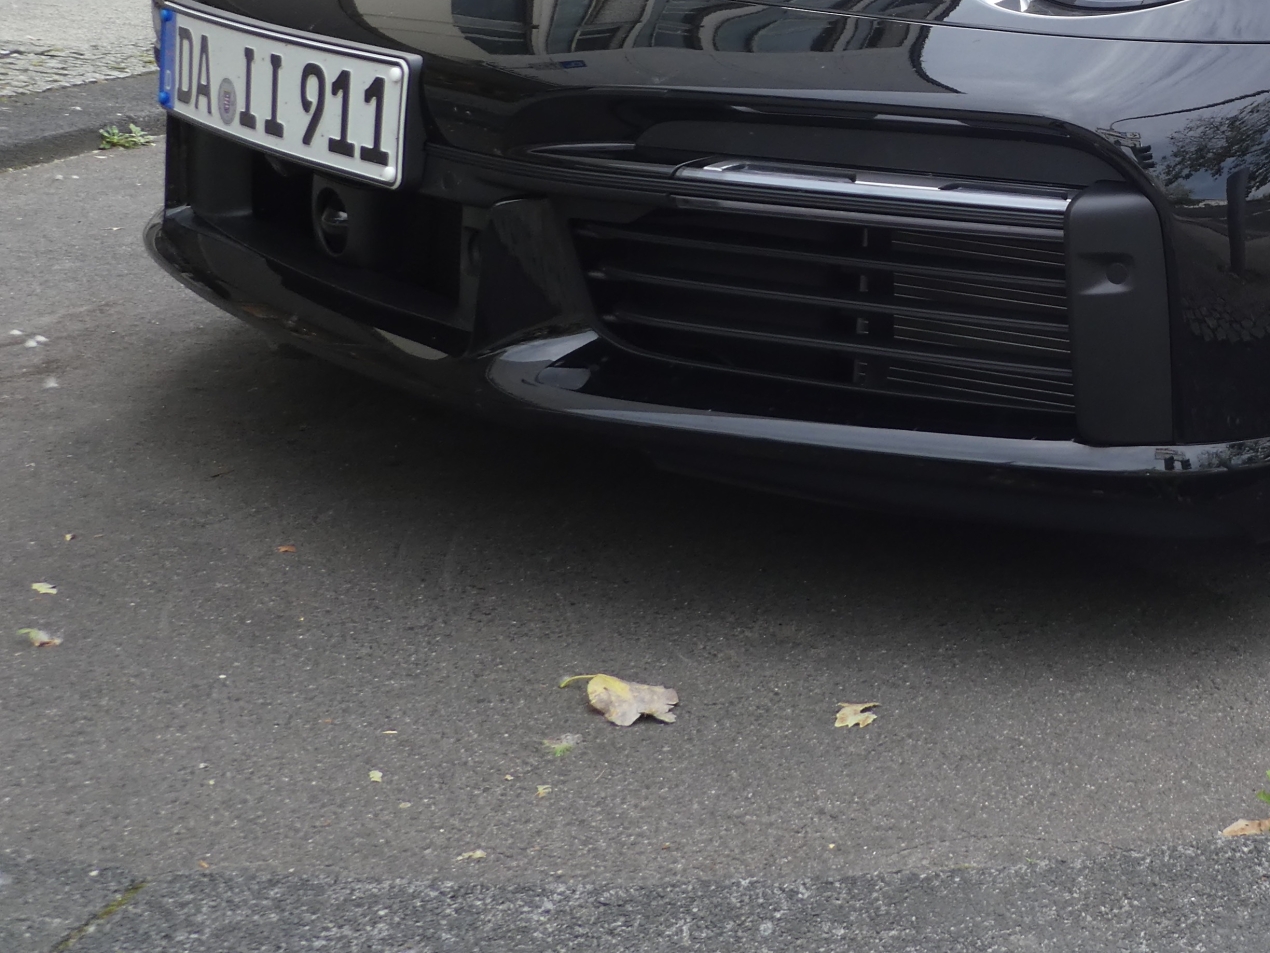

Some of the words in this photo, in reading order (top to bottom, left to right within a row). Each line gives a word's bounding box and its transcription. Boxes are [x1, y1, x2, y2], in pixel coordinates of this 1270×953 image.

[176, 25, 213, 115] DA
[239, 46, 284, 139] II
[300, 61, 390, 167] 911
